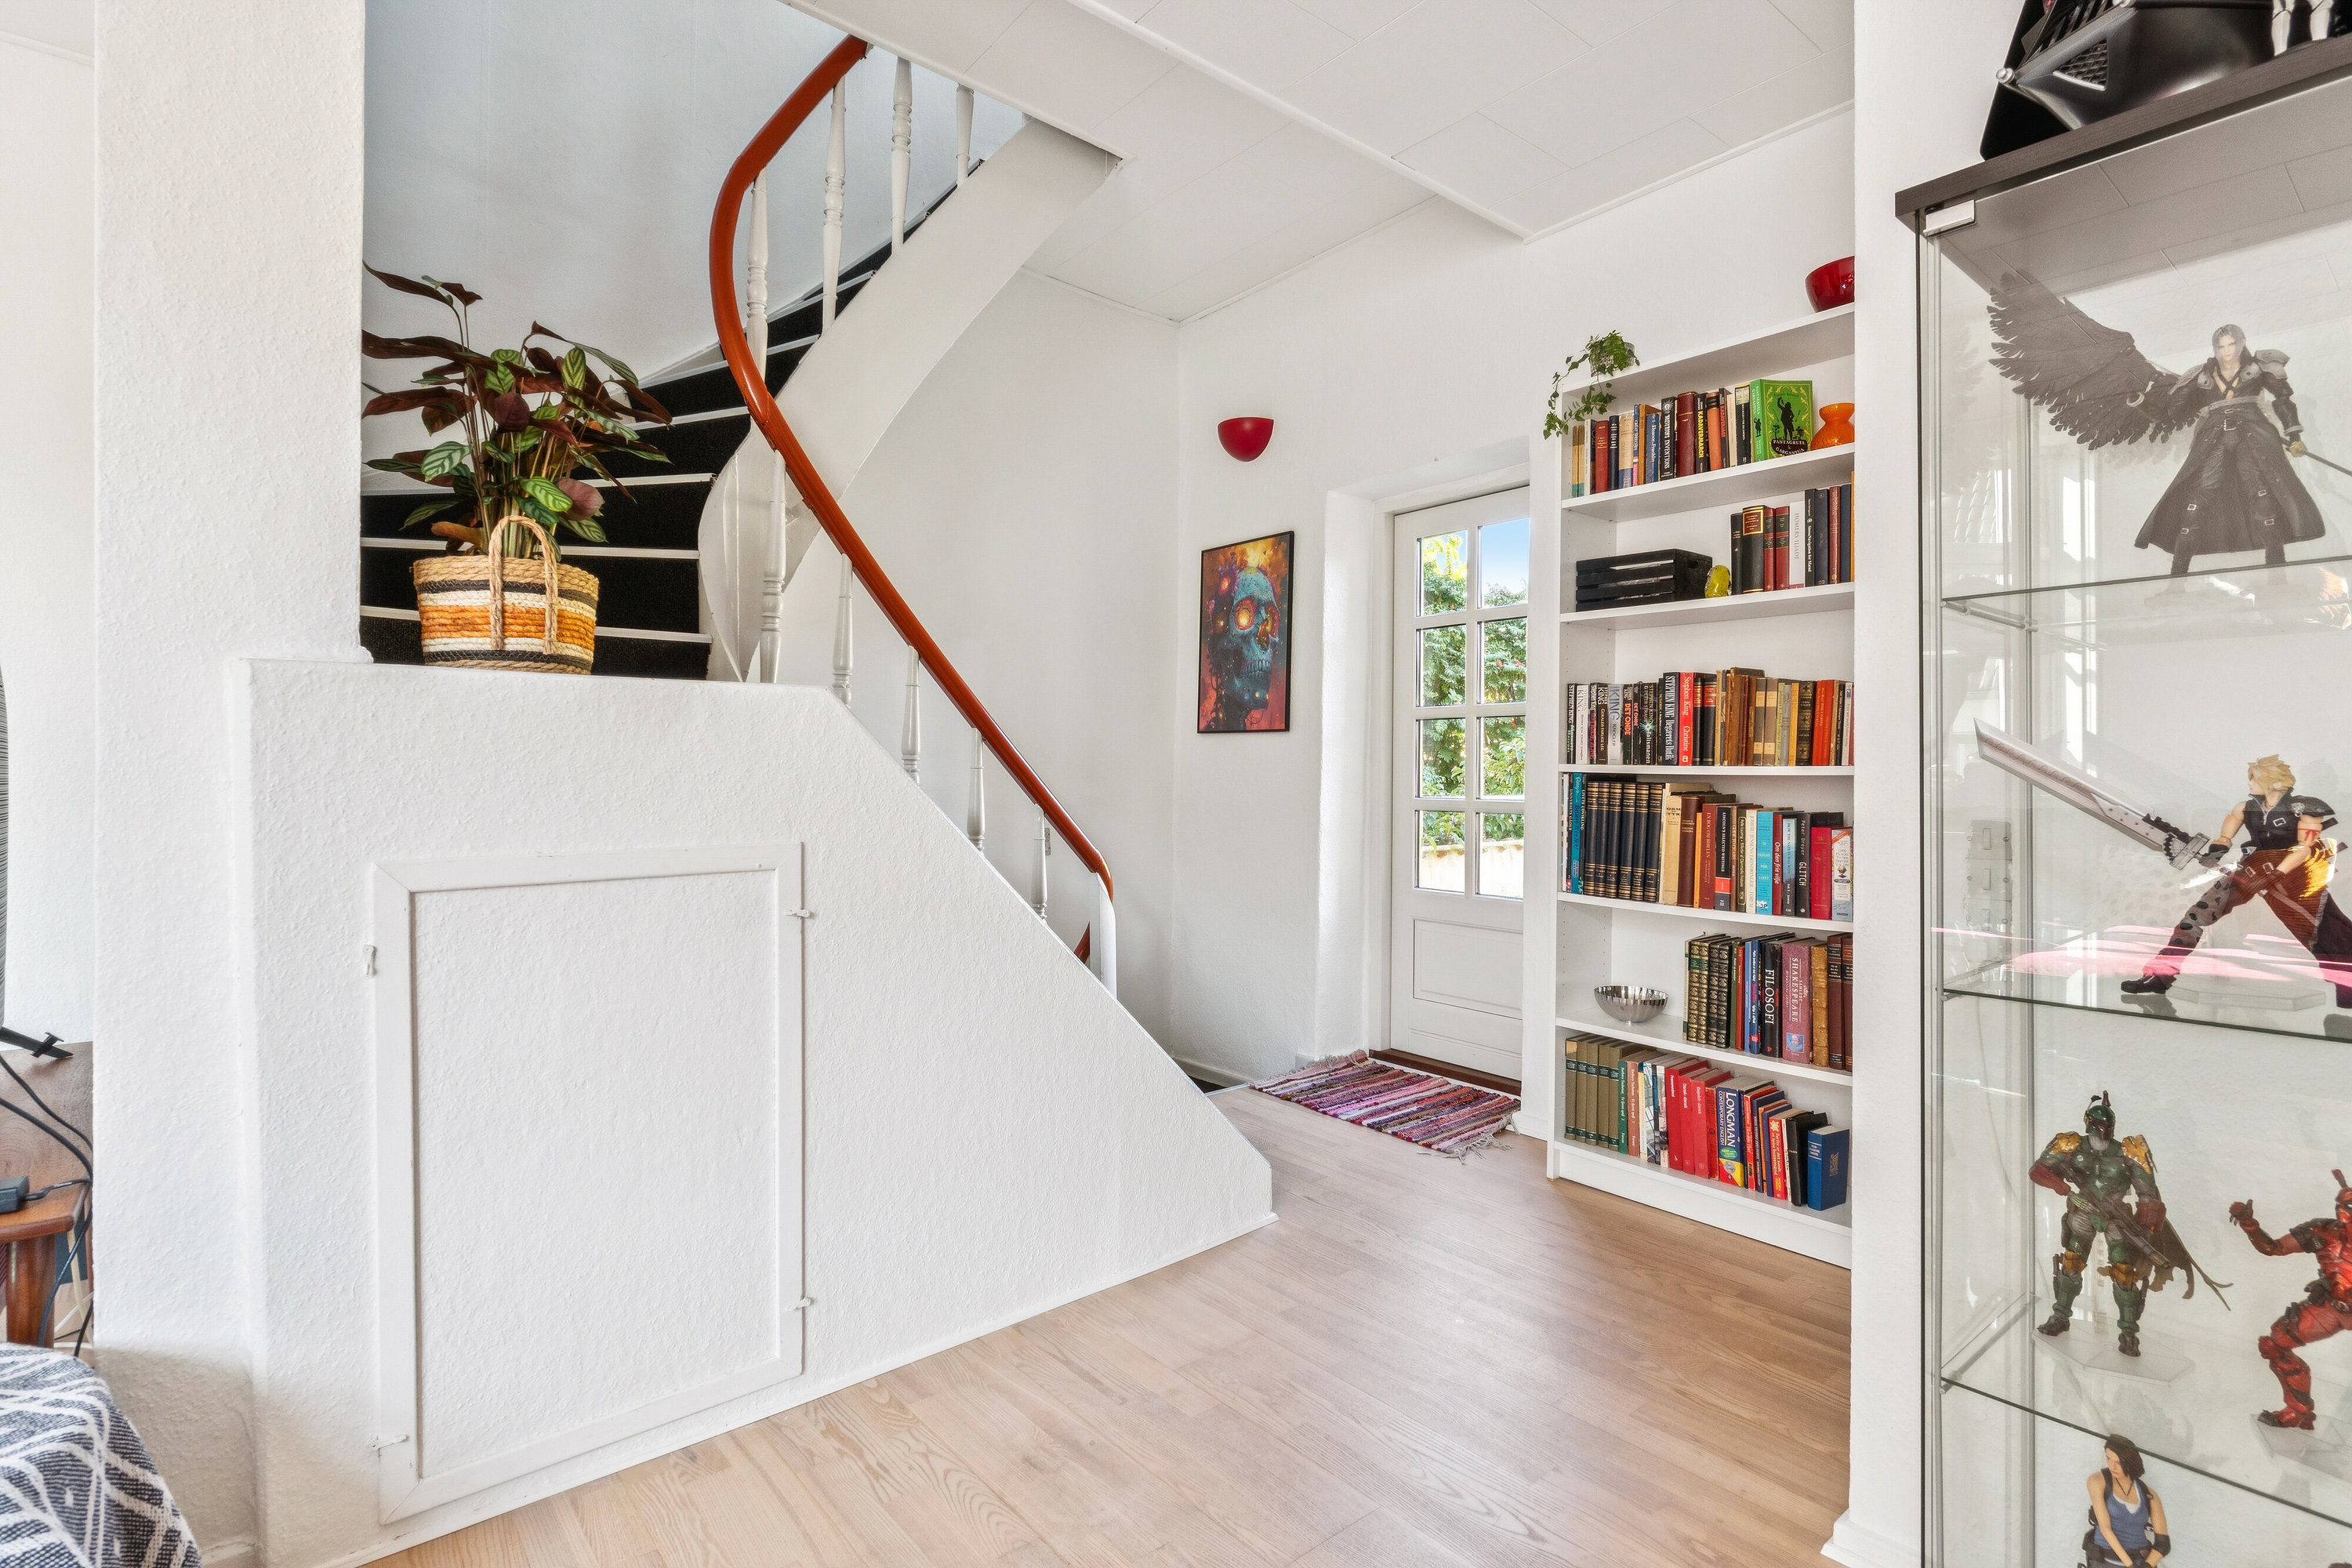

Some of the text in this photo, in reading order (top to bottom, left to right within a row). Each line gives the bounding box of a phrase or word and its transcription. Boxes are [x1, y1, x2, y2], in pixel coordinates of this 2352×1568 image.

[1682, 677, 1691, 699] Stephen
[1664, 676, 1675, 760] STEPHEN KING Begærets Butik
[1682, 701, 1690, 715] King
[1775, 842, 1780, 852] Om
[1772, 862, 1780, 872] frie
[1765, 969, 1775, 1024] FILOSOFI
[1726, 1091, 1737, 1147] LONGMAN
